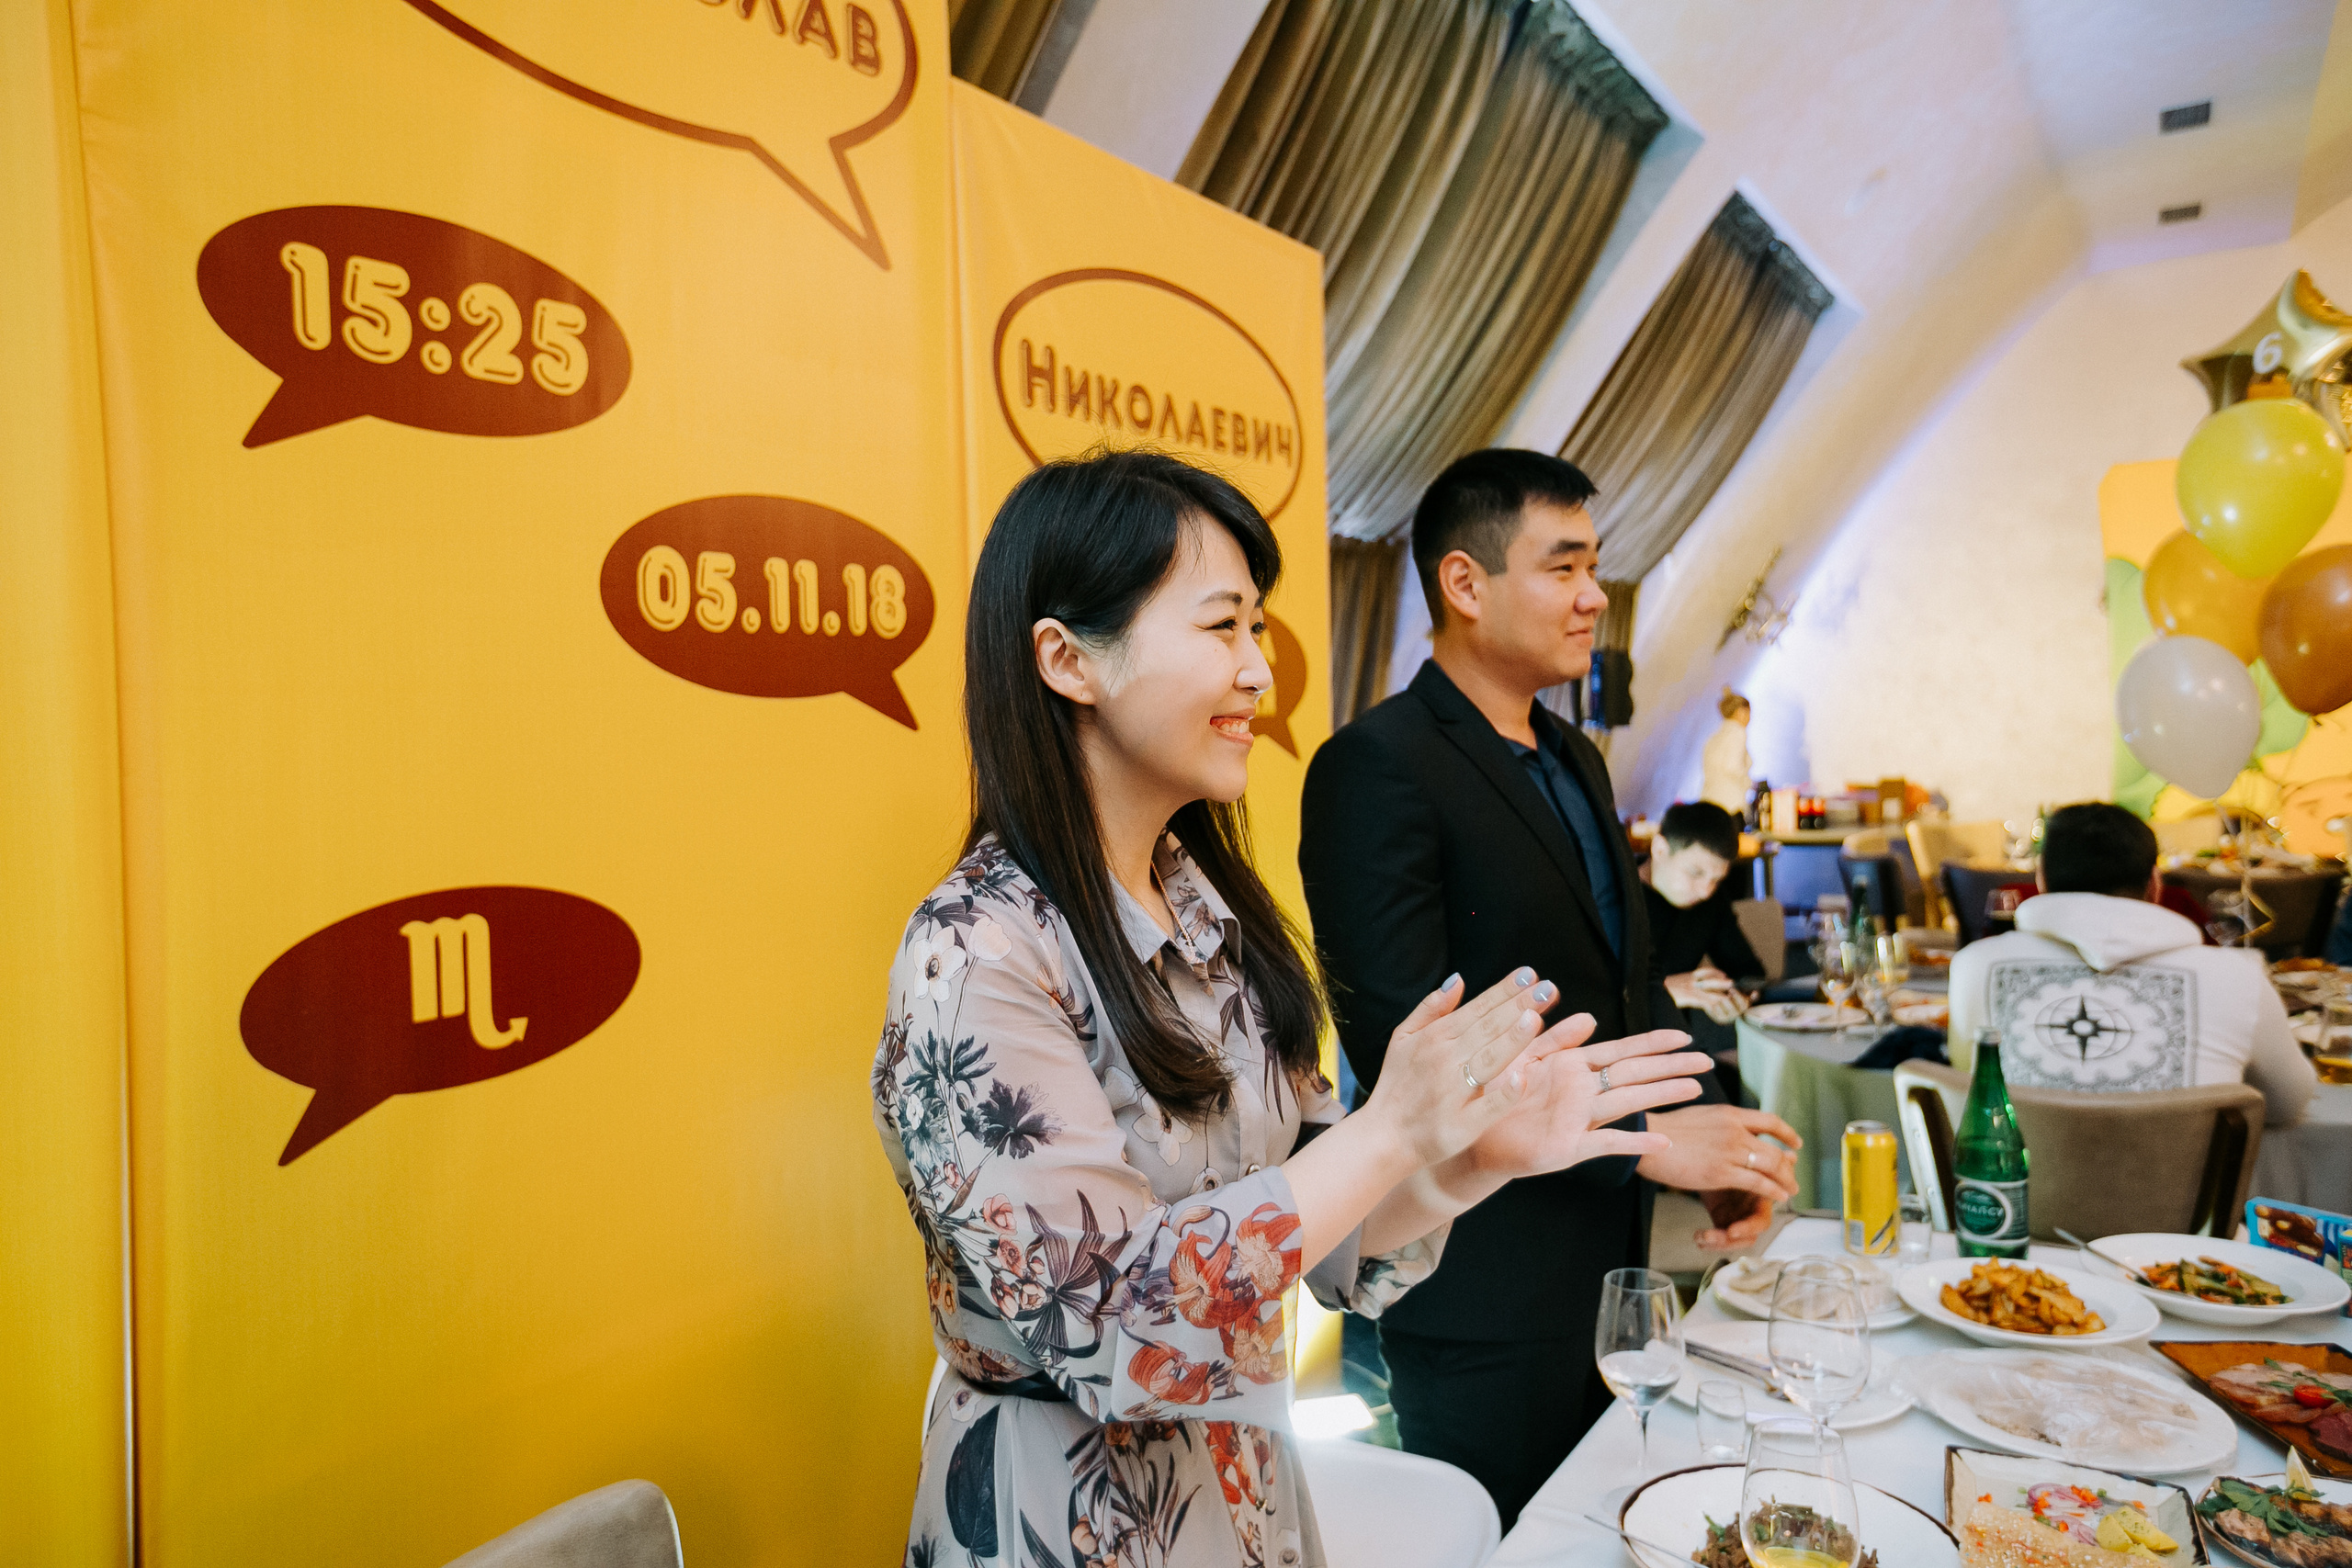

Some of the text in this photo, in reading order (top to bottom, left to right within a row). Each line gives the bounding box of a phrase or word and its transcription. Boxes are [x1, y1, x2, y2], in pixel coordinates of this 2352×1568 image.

[280, 241, 590, 397] 15:25
[2253, 331, 2283, 375] 6
[636, 544, 908, 640] 05.11.18
